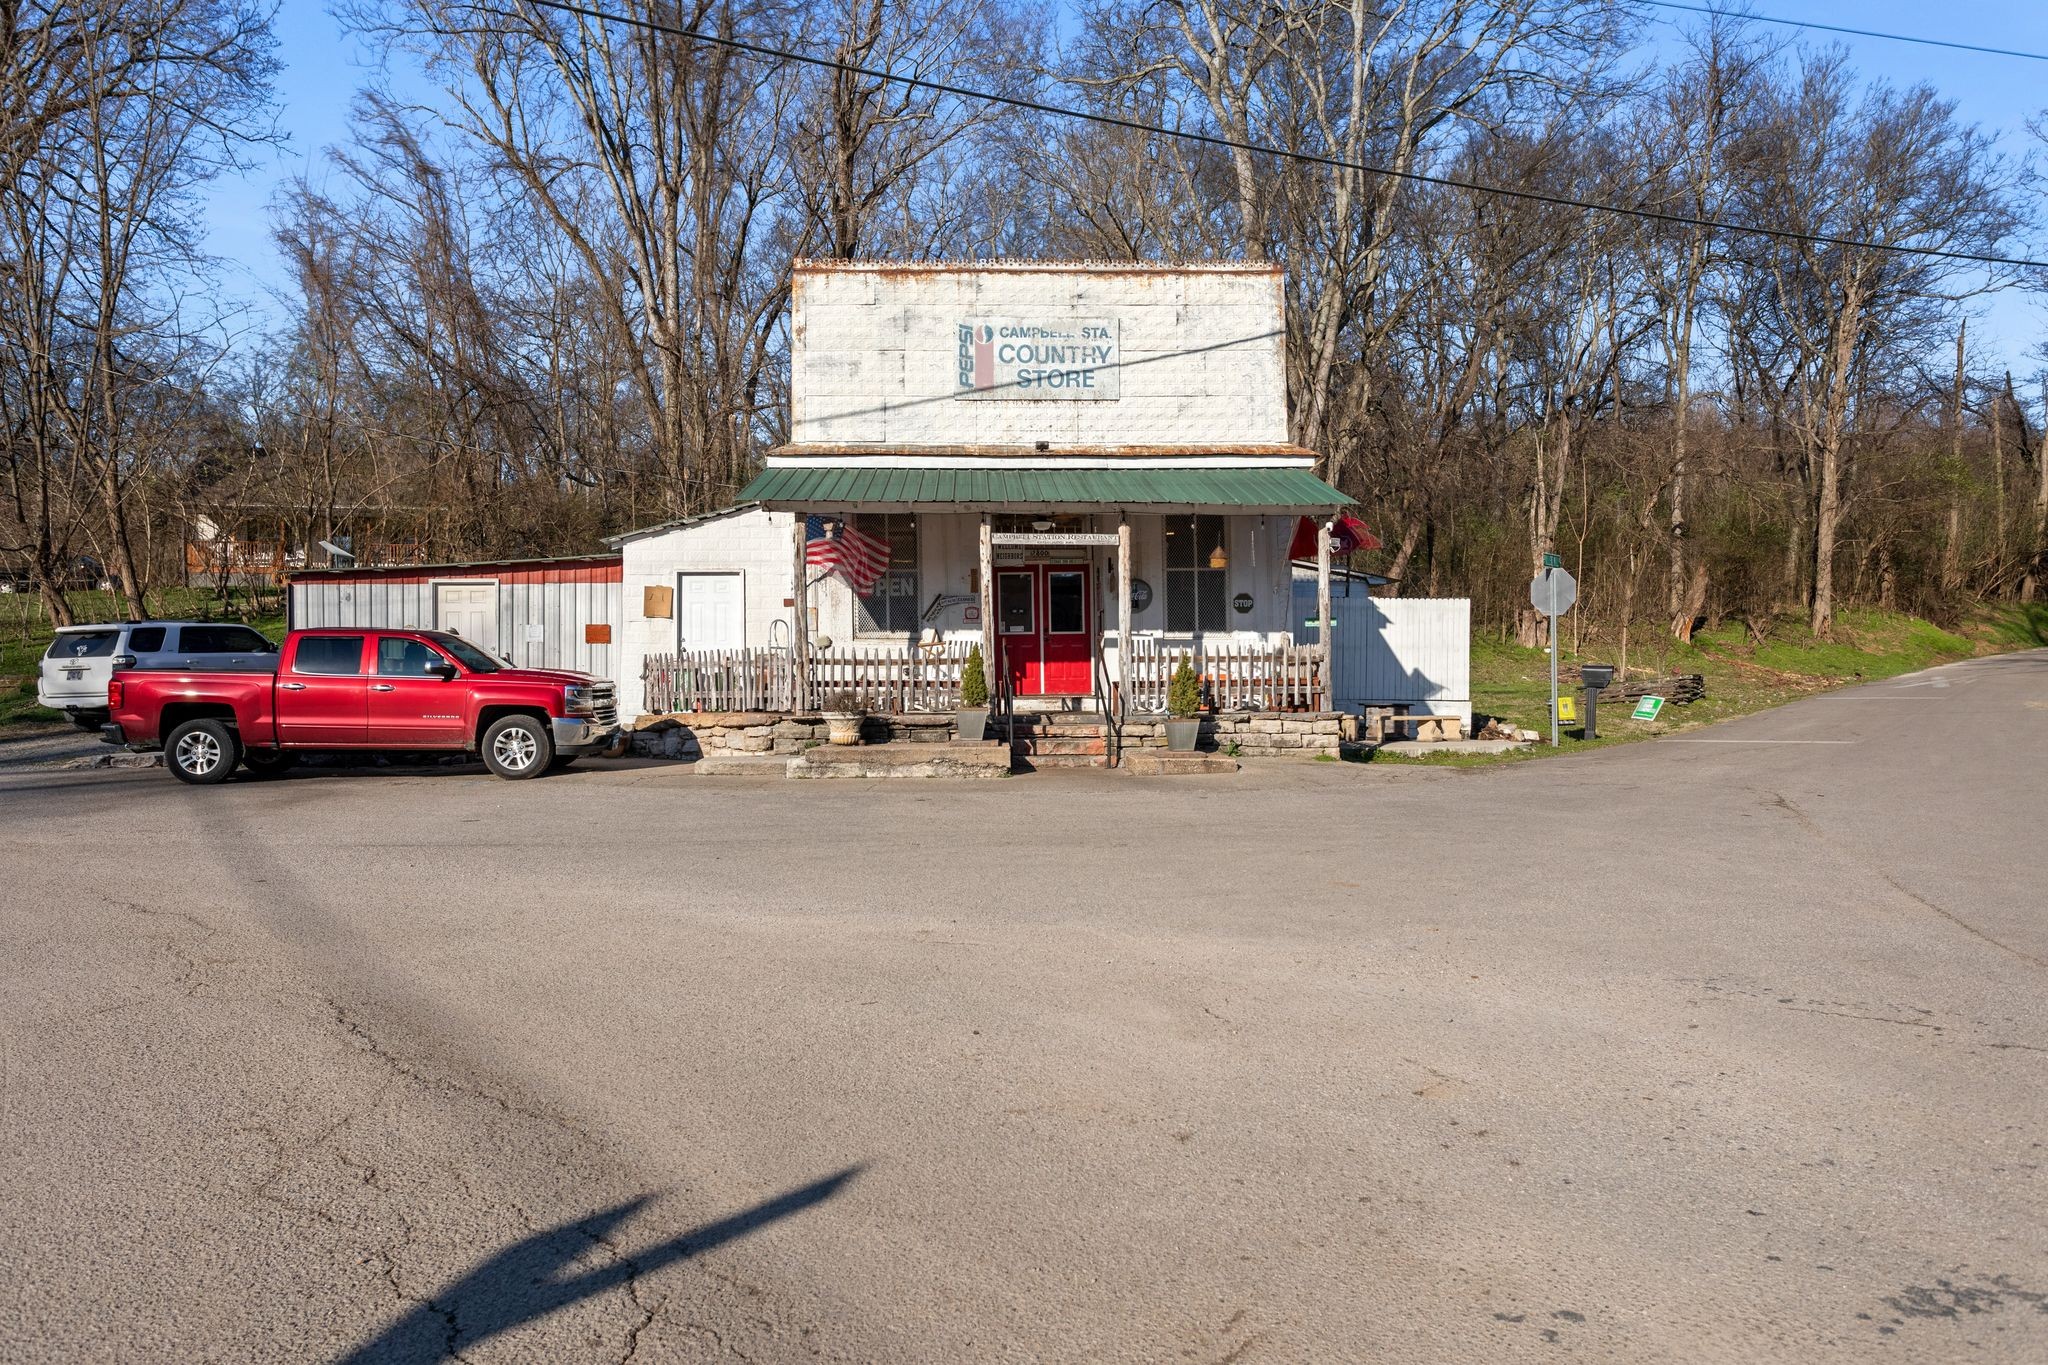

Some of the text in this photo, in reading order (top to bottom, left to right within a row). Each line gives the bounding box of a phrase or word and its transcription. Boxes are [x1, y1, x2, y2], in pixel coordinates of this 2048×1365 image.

[999, 326, 1113, 339] CAMPBELL STA.
[958, 324, 975, 388] PEPSI
[998, 343, 1112, 364] COUNTRY
[1016, 368, 1095, 389] STORE
[874, 577, 914, 596] PEN
[1234, 599, 1253, 607] STOP
